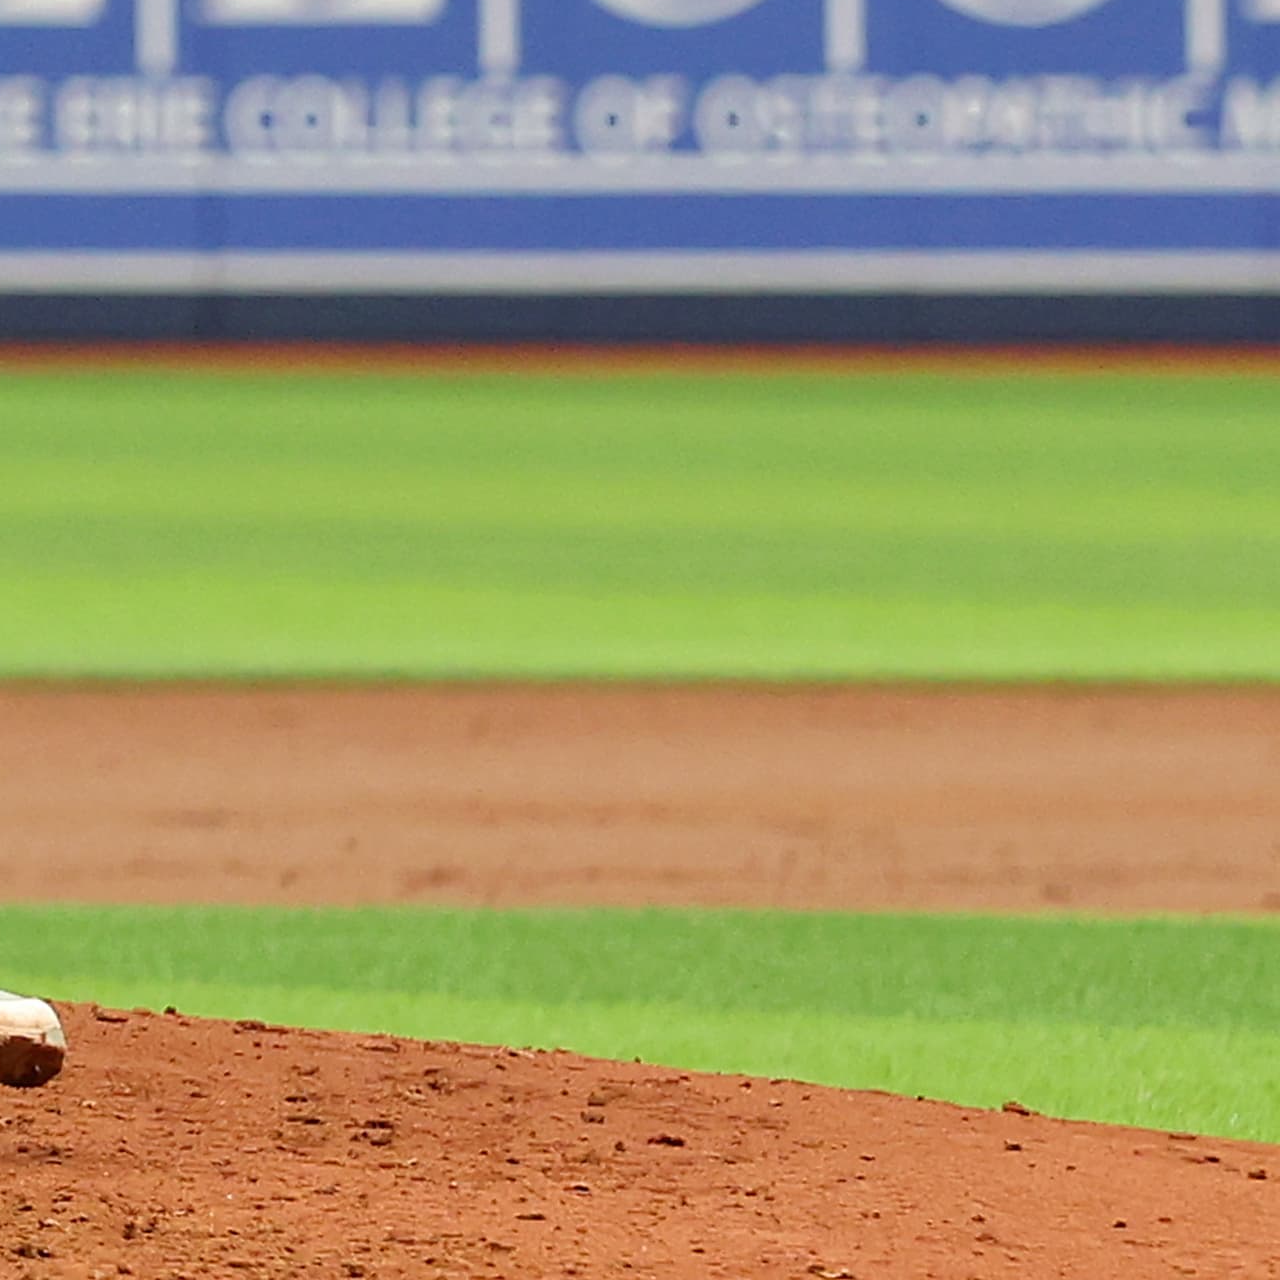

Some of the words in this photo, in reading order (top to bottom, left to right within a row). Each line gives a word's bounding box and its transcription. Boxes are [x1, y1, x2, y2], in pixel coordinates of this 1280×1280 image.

[53, 75, 216, 160] ERIE
[225, 73, 568, 160] COLLEGE
[573, 73, 687, 160] OF
[693, 73, 1222, 160] OSTEOPATHIC
